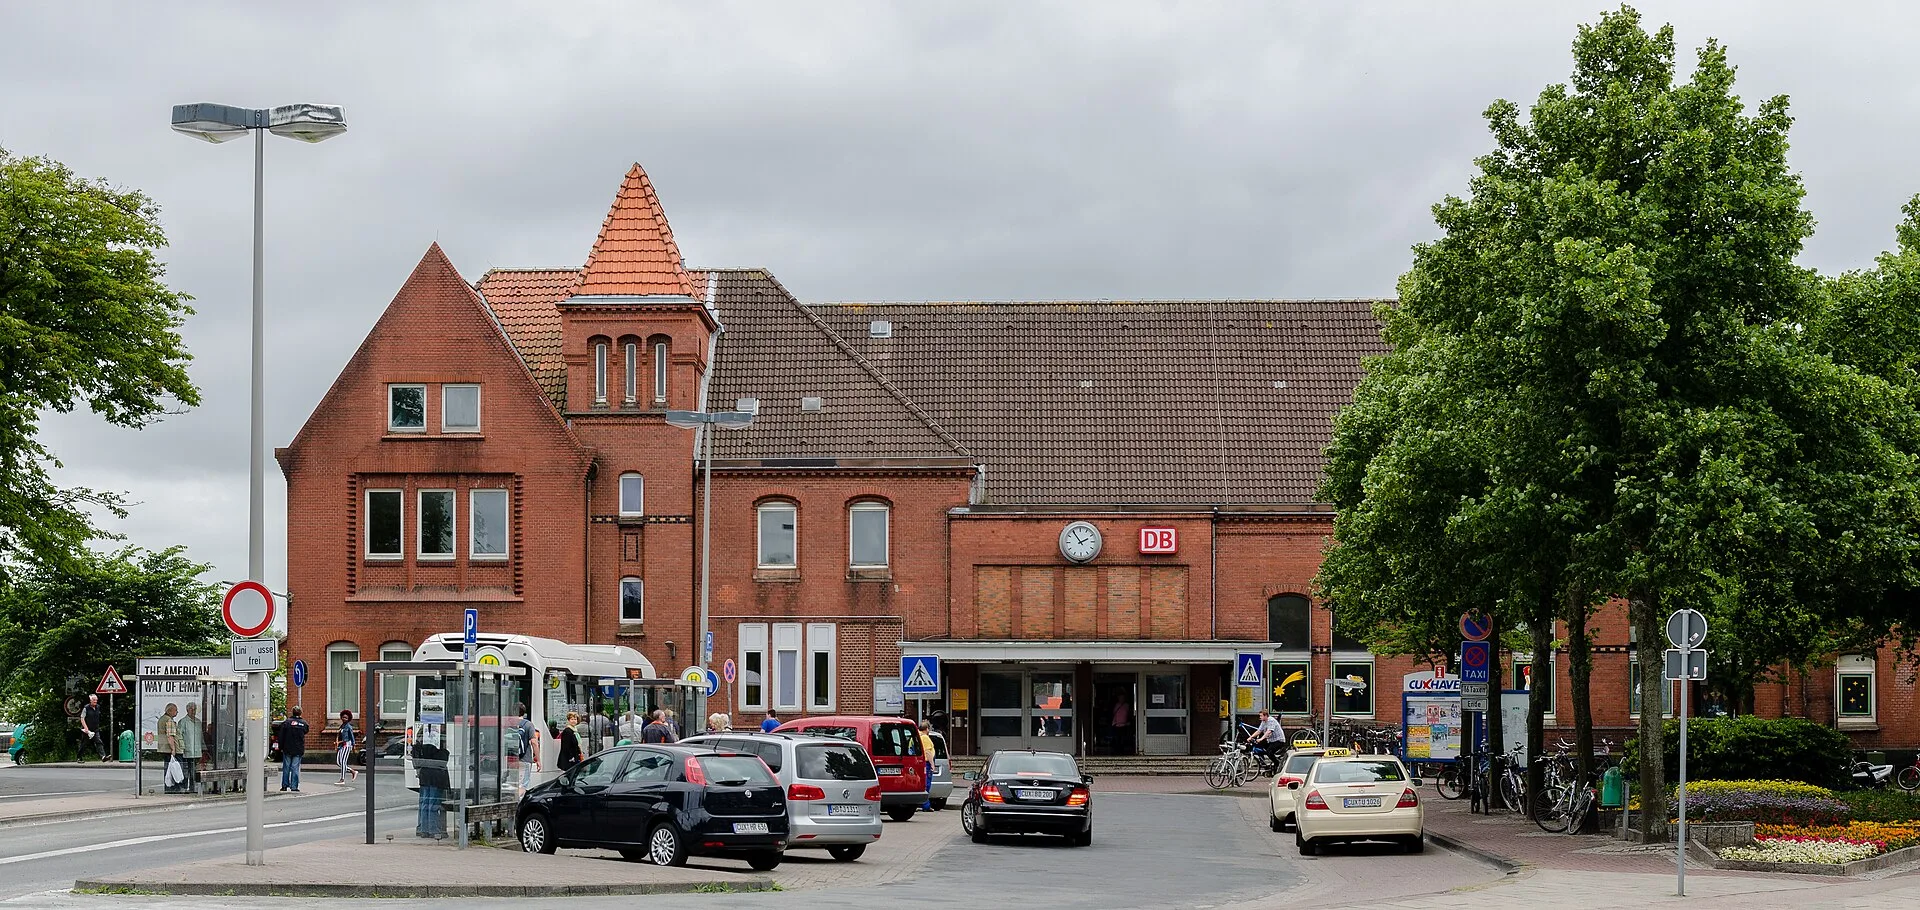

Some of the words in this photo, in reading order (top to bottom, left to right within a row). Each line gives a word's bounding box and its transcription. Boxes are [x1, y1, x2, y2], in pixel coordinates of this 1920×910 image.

[1145, 531, 1172, 548] DB
[466, 613, 474, 639] P
[248, 656, 261, 665] frei
[144, 666, 161, 675] THE
[164, 666, 210, 675] AMERICAN
[1465, 670, 1486, 678] TAXI
[144, 681, 163, 692] WAY
[165, 681, 176, 692] OF
[1409, 678, 1460, 690] CUXHAVE
[737, 823, 747, 831] CUX
